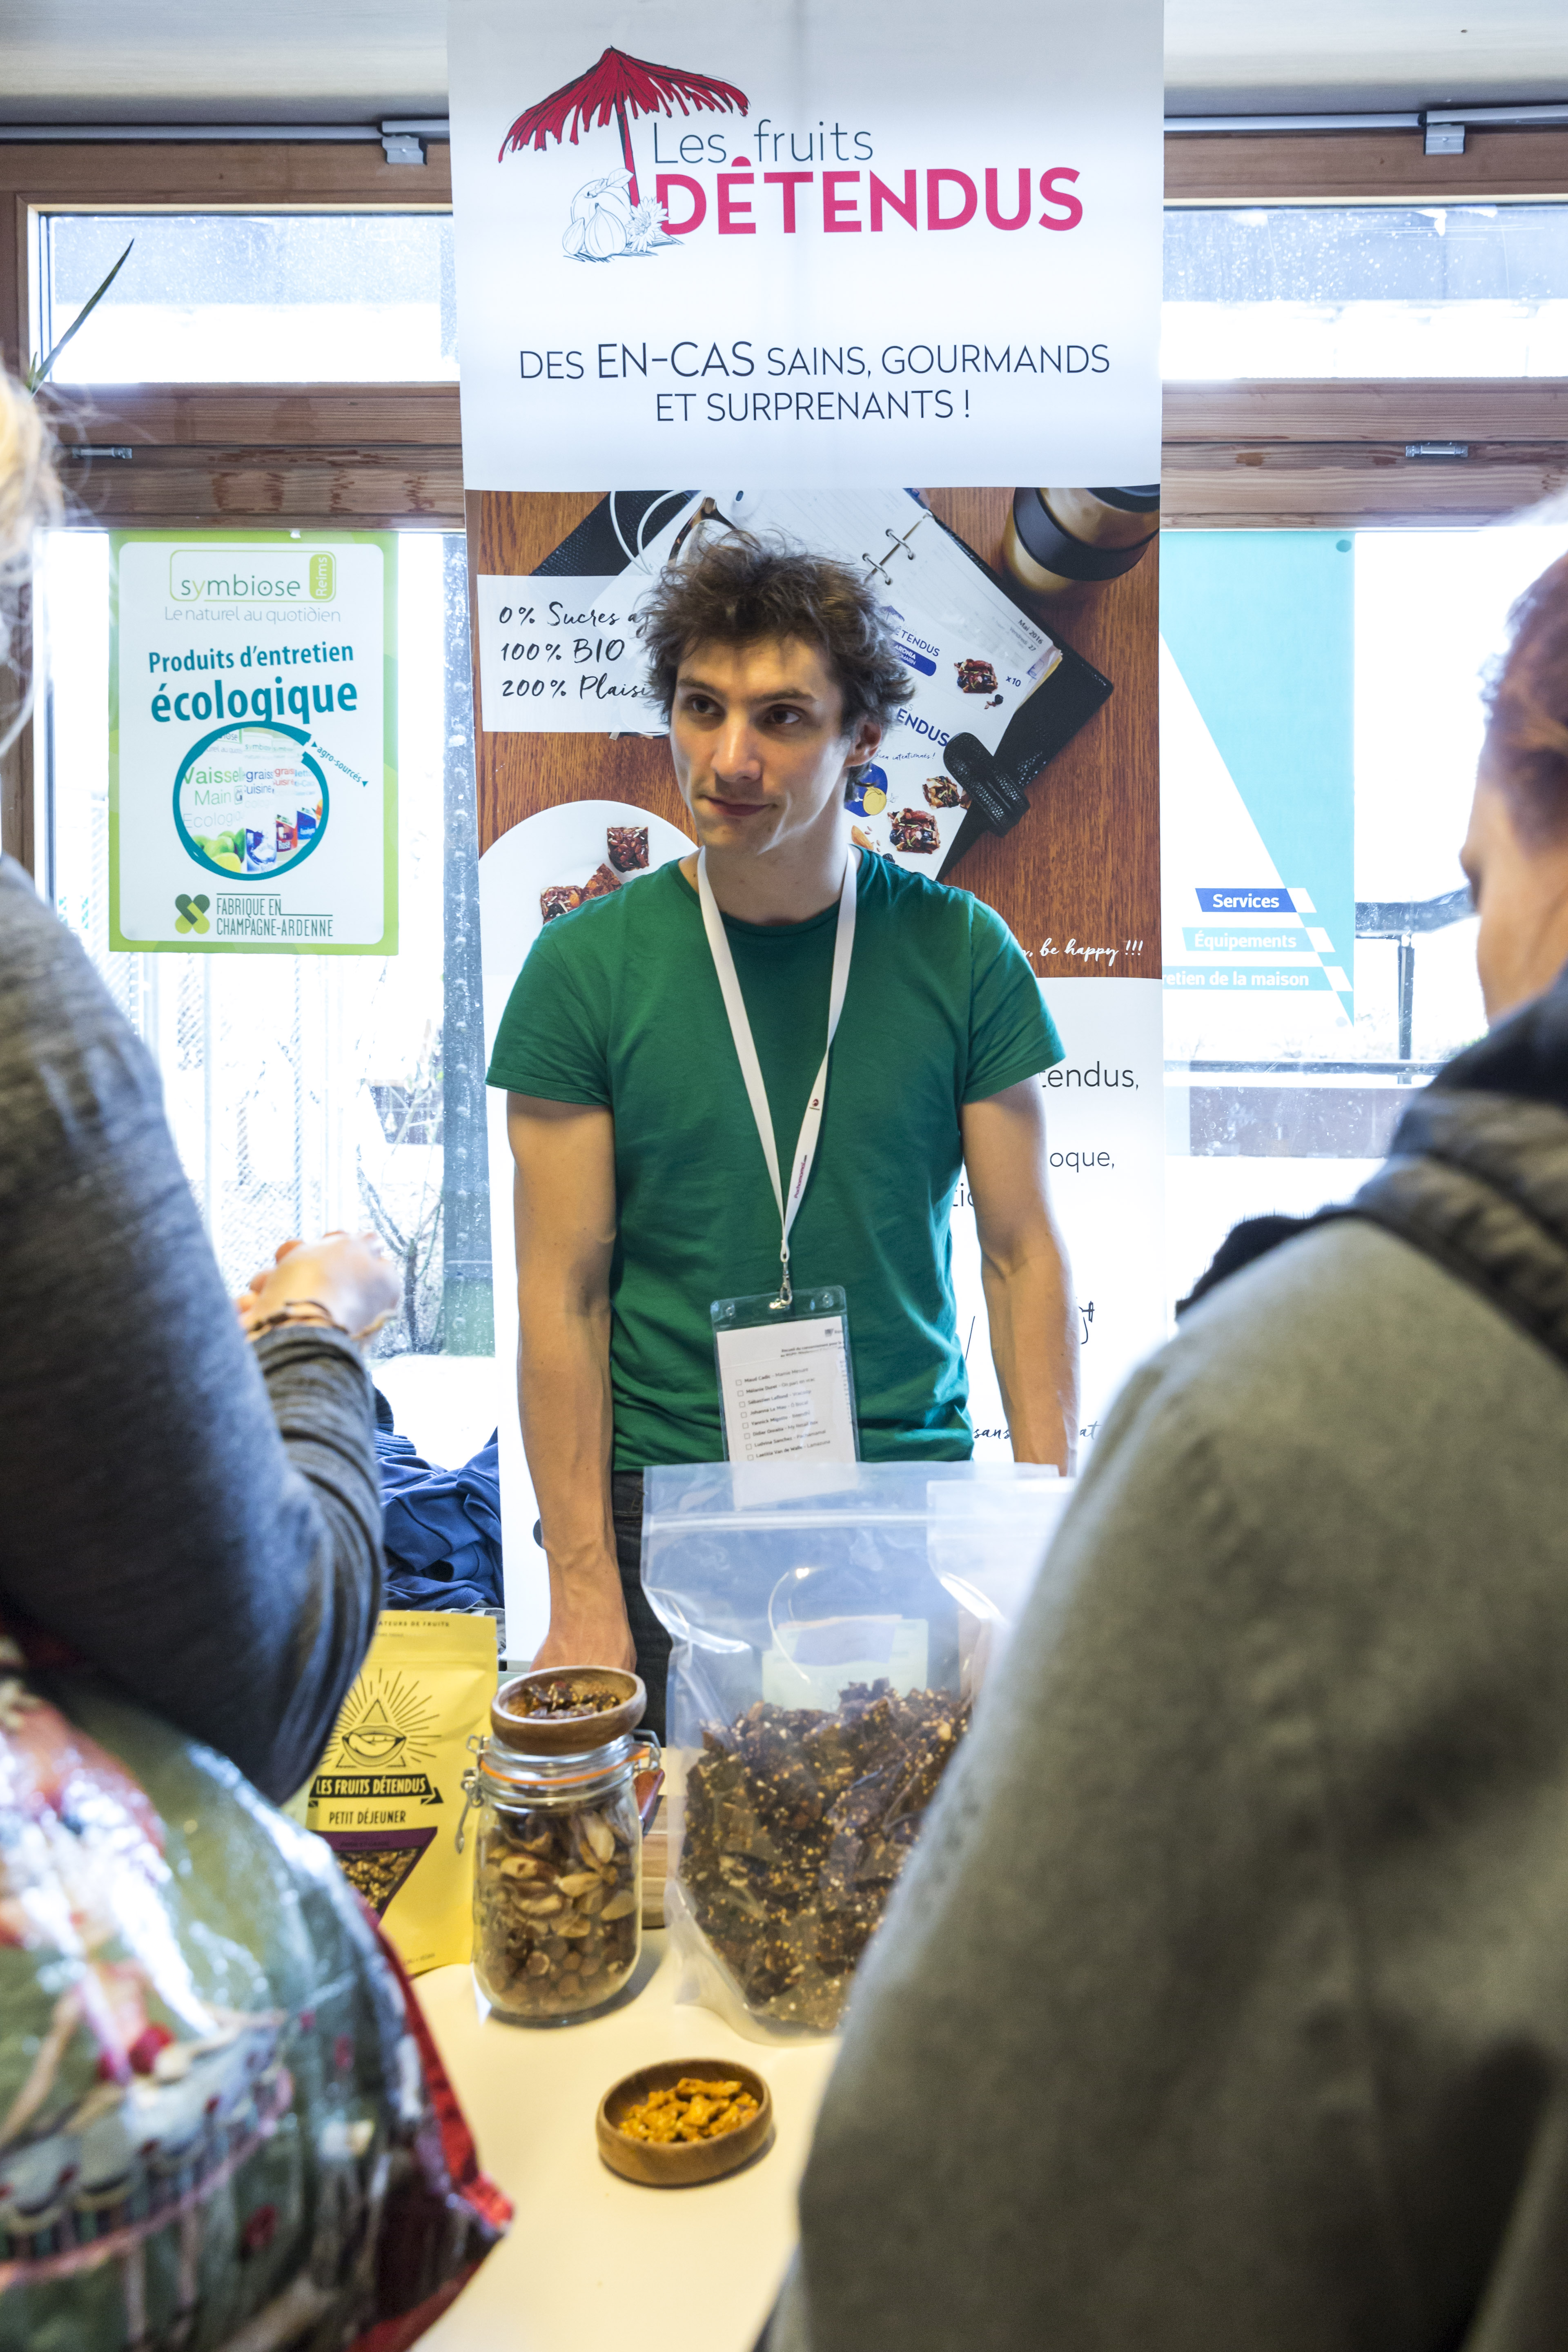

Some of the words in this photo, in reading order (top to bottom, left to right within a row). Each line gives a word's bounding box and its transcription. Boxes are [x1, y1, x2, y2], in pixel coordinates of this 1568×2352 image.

[654, 122, 726, 164] Les
[755, 119, 874, 161] fruits
[519, 351, 584, 379] DES
[597, 341, 755, 378] EN-CAS
[768, 346, 871, 380] SAINS,
[882, 344, 1110, 374] GOURMANDS
[657, 394, 696, 421] ET
[707, 390, 952, 421] SURPRENANTS
[181, 574, 300, 599] symbiose
[316, 557, 327, 597] Reims
[165, 607, 183, 620] Le
[186, 606, 240, 621] naturel
[245, 610, 262, 621] au
[266, 607, 341, 624] quotidien
[547, 601, 619, 626] Sucres
[1018, 619, 1030, 631] Mai
[1029, 630, 1044, 644] 2016
[149, 648, 234, 673] Produits
[240, 641, 353, 667] d'entretien
[501, 642, 561, 661] 100%
[573, 638, 625, 663] BIO
[502, 679, 566, 698] 200%
[580, 673, 650, 699] Plaisi
[151, 676, 357, 724] écologique
[897, 708, 950, 746] ENDUS
[317, 746, 362, 783] agro-sourcés
[195, 789, 231, 806] Main
[217, 898, 265, 918] FABRIQUE
[269, 899, 281, 915] EN
[1213, 893, 1280, 908] Services
[217, 918, 333, 936] CHAMPAGNE-ARDENNE
[1040, 938, 1060, 956] be
[1064, 938, 1119, 966] happy
[1194, 930, 1297, 951] Équipements
[1162, 971, 1206, 985] retien
[1209, 971, 1229, 985] de
[1233, 971, 1248, 985] la
[1251, 971, 1309, 986] maison
[1050, 1152, 1115, 1173] oque,
[316, 1779, 332, 1795] LES
[334, 1778, 370, 1795] FRUITS
[372, 1775, 426, 1794] DÉTENDUS
[329, 1811, 354, 1824] PETIT
[357, 1807, 406, 1824] DÉJEUNER
